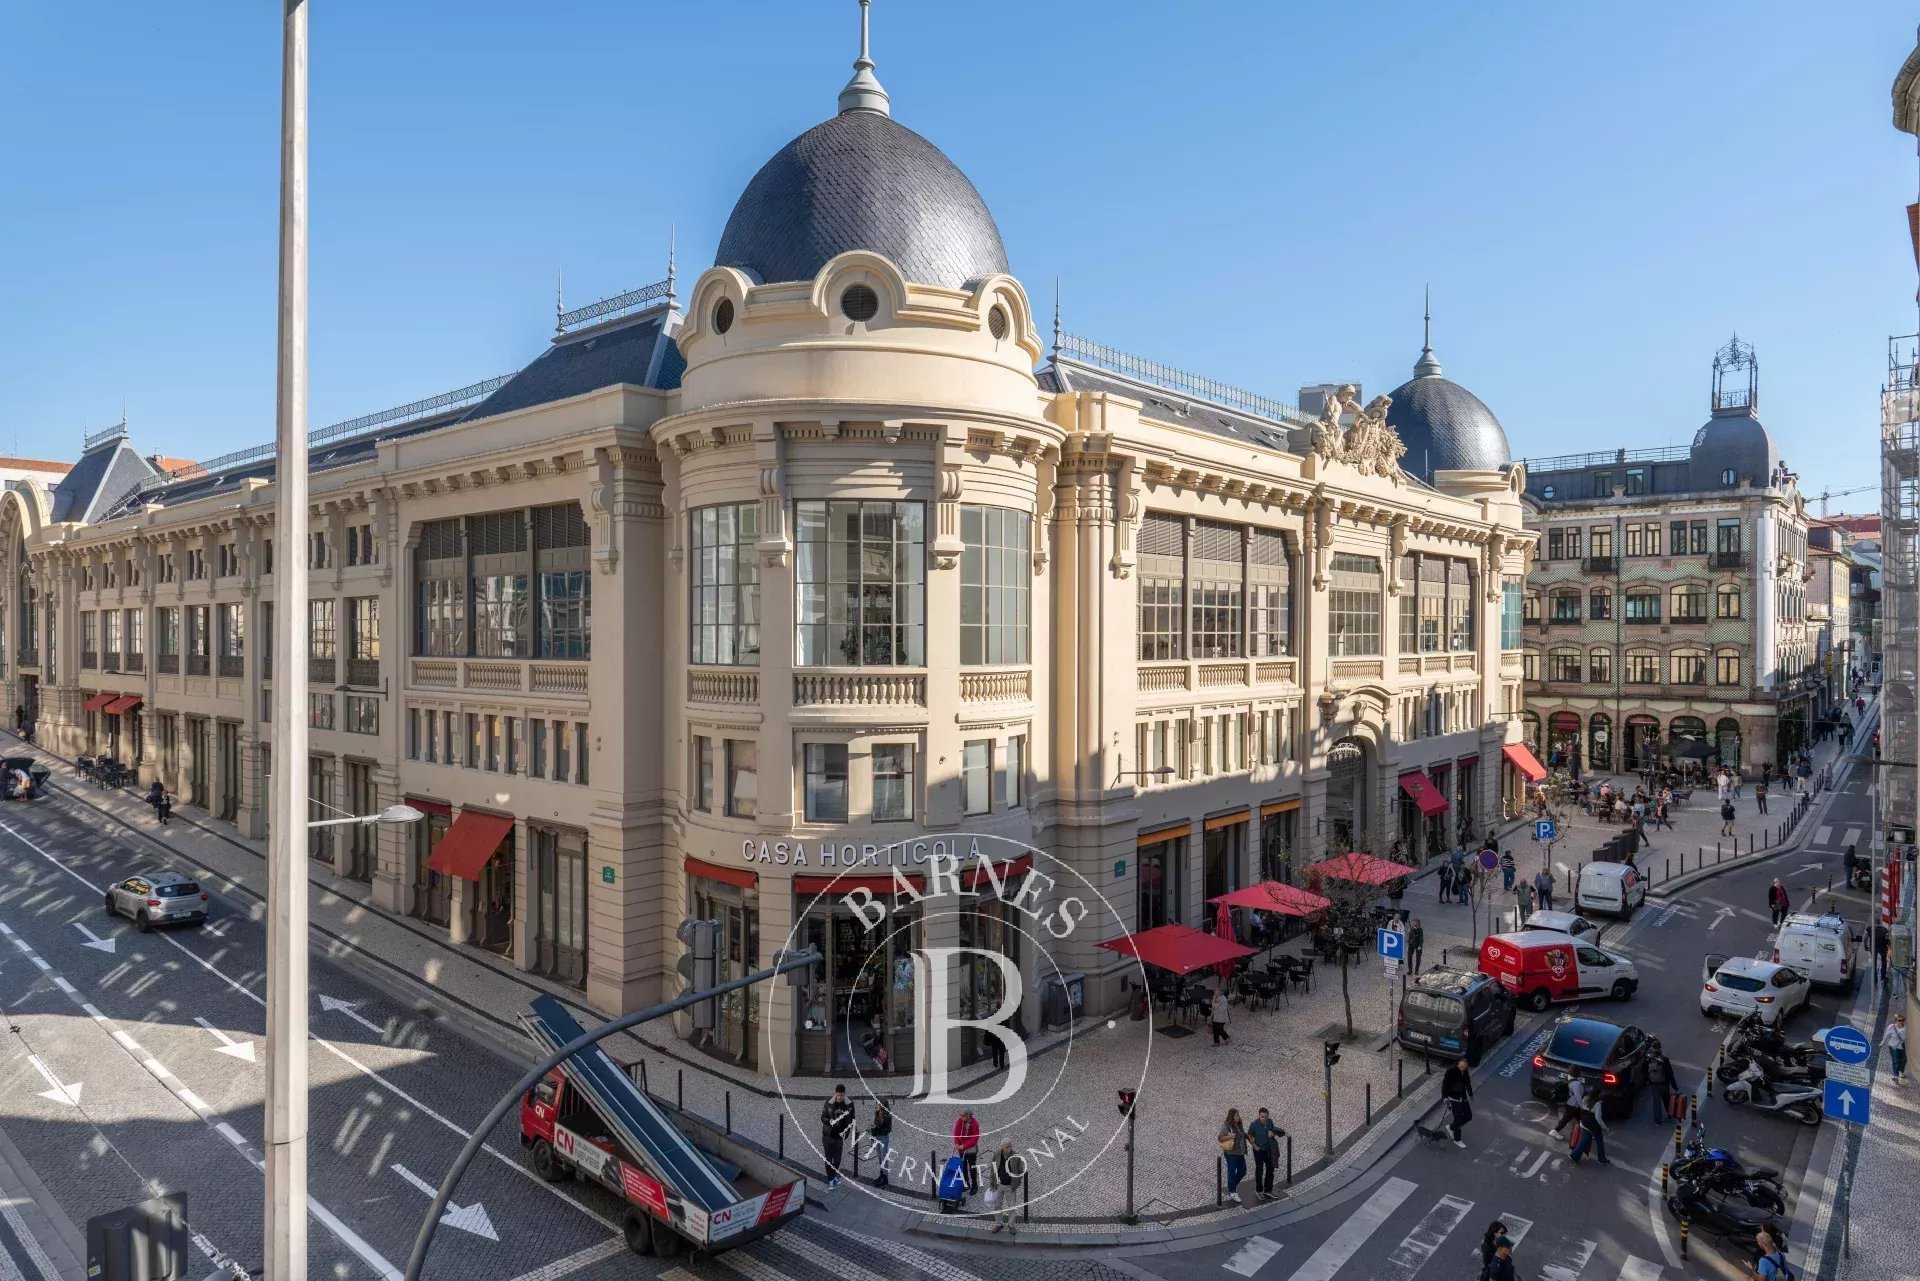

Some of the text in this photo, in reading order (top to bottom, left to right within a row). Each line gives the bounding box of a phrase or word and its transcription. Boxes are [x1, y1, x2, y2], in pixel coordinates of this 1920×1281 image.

[1540, 823, 1550, 837] P
[742, 837, 981, 867] CASA HORTICOLA
[1383, 932, 1398, 954] P
[535, 1105, 545, 1118] CN
[556, 1128, 575, 1155] CN
[713, 1209, 732, 1225] CN
